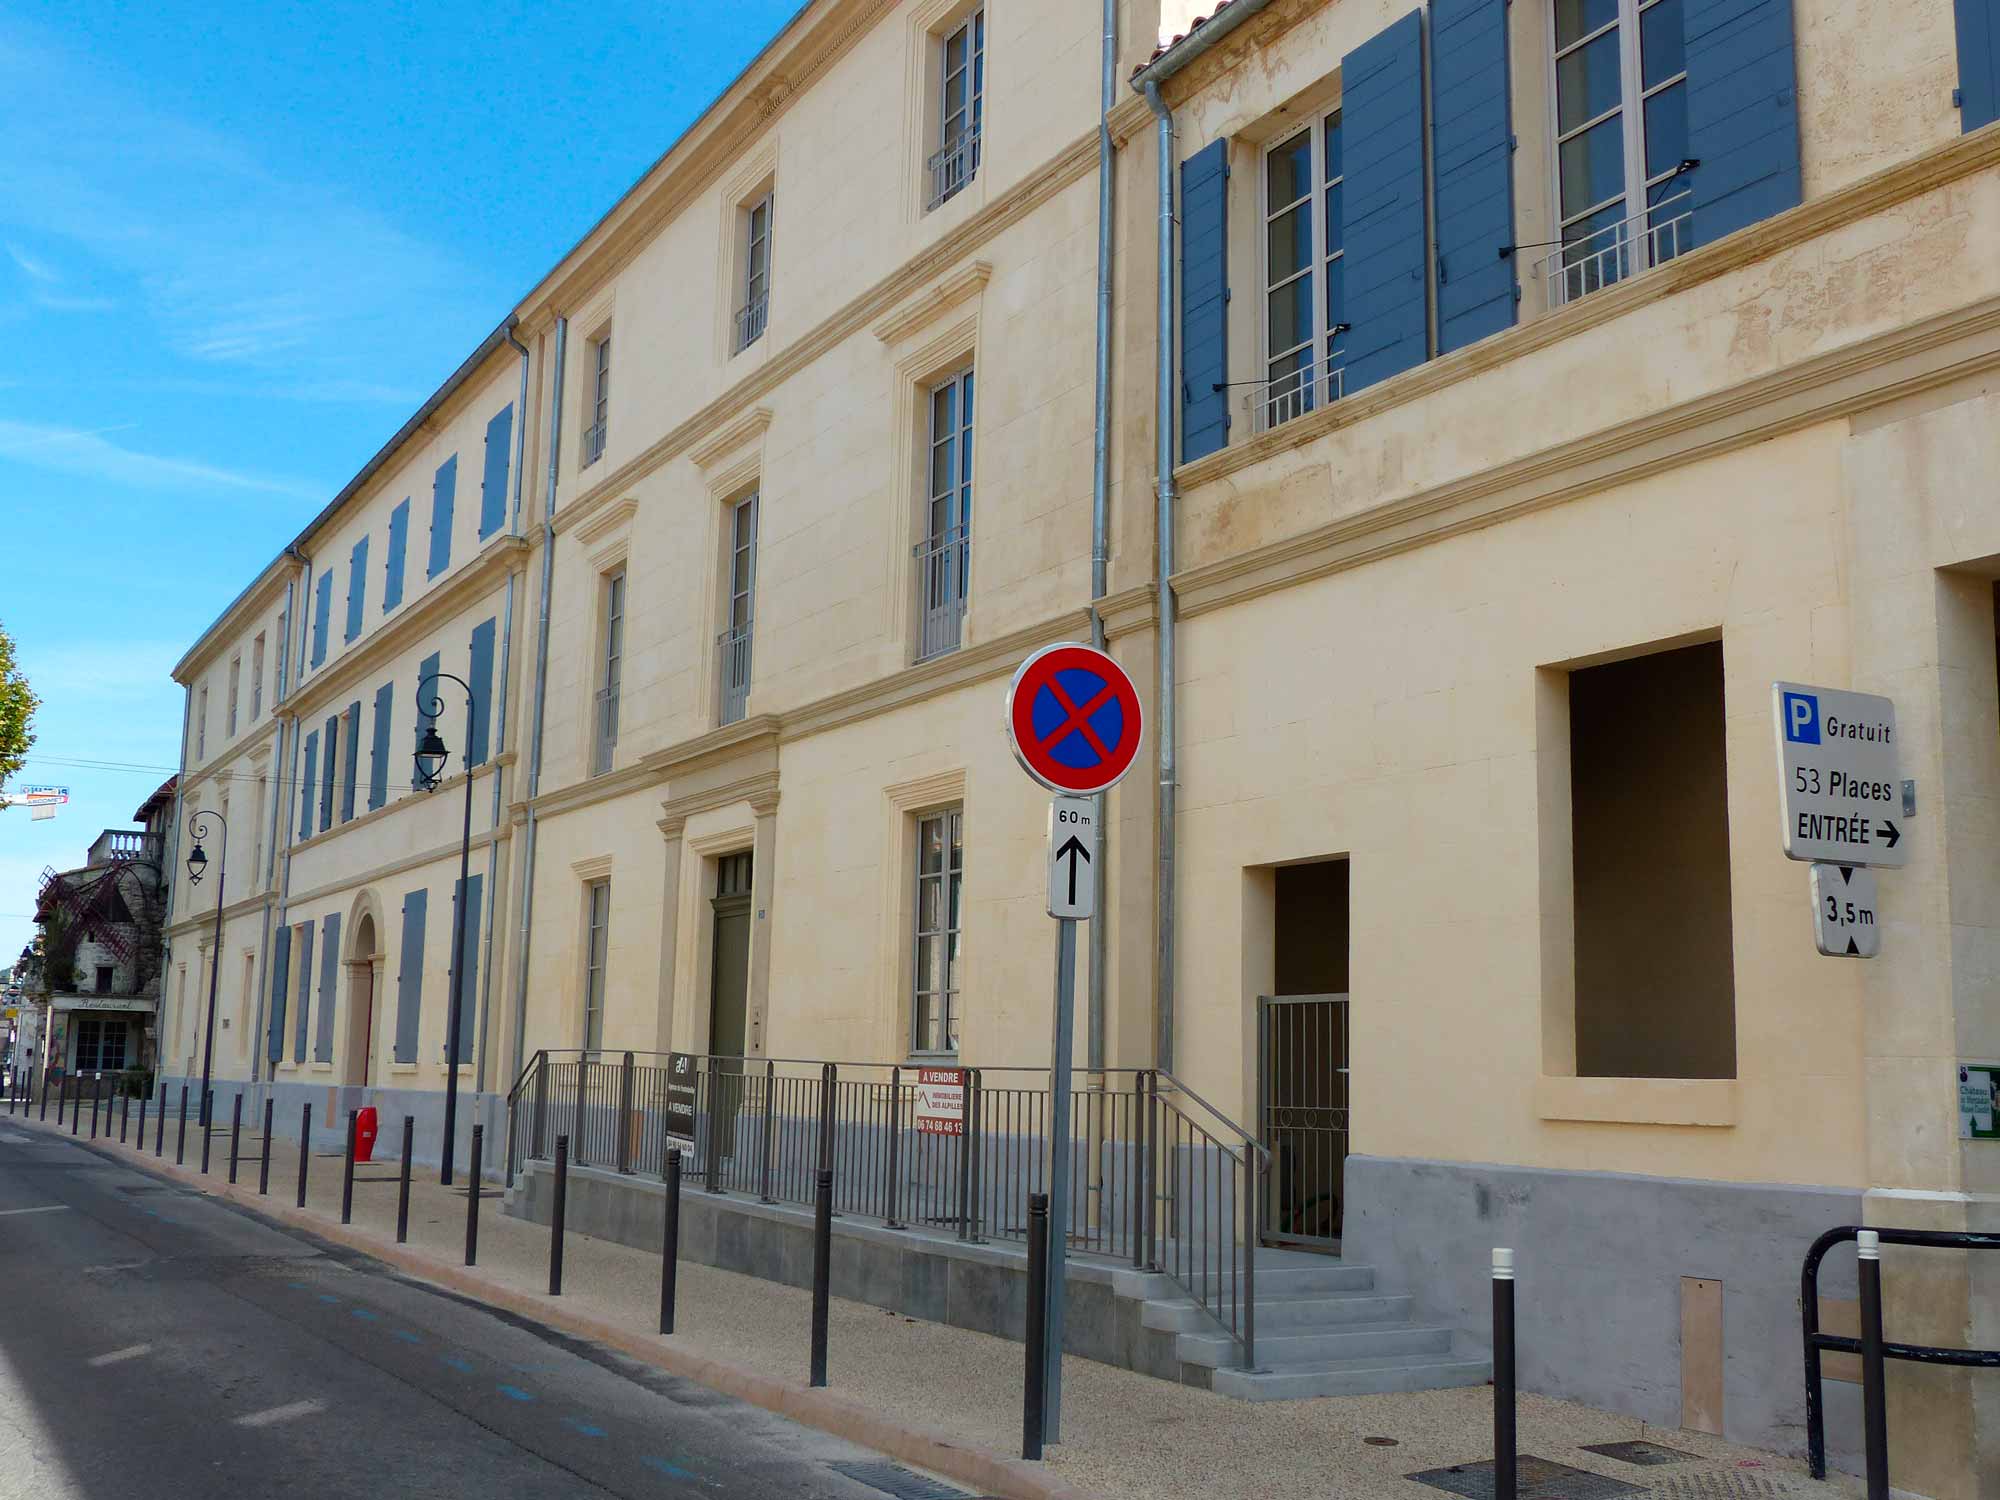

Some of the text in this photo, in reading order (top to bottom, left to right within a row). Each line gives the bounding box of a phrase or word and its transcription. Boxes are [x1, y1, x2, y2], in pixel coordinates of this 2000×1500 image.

[1790, 698, 1812, 737] P
[1827, 716, 1891, 744] Gratuit
[1795, 766, 1892, 801] 53 Places
[1797, 812, 1870, 844] ENTRÉE
[922, 1071, 959, 1083] A VENDRE
[672, 1102, 693, 1116] VENDRE
[926, 1119, 933, 1130] 74
[954, 1122, 963, 1134] 13
